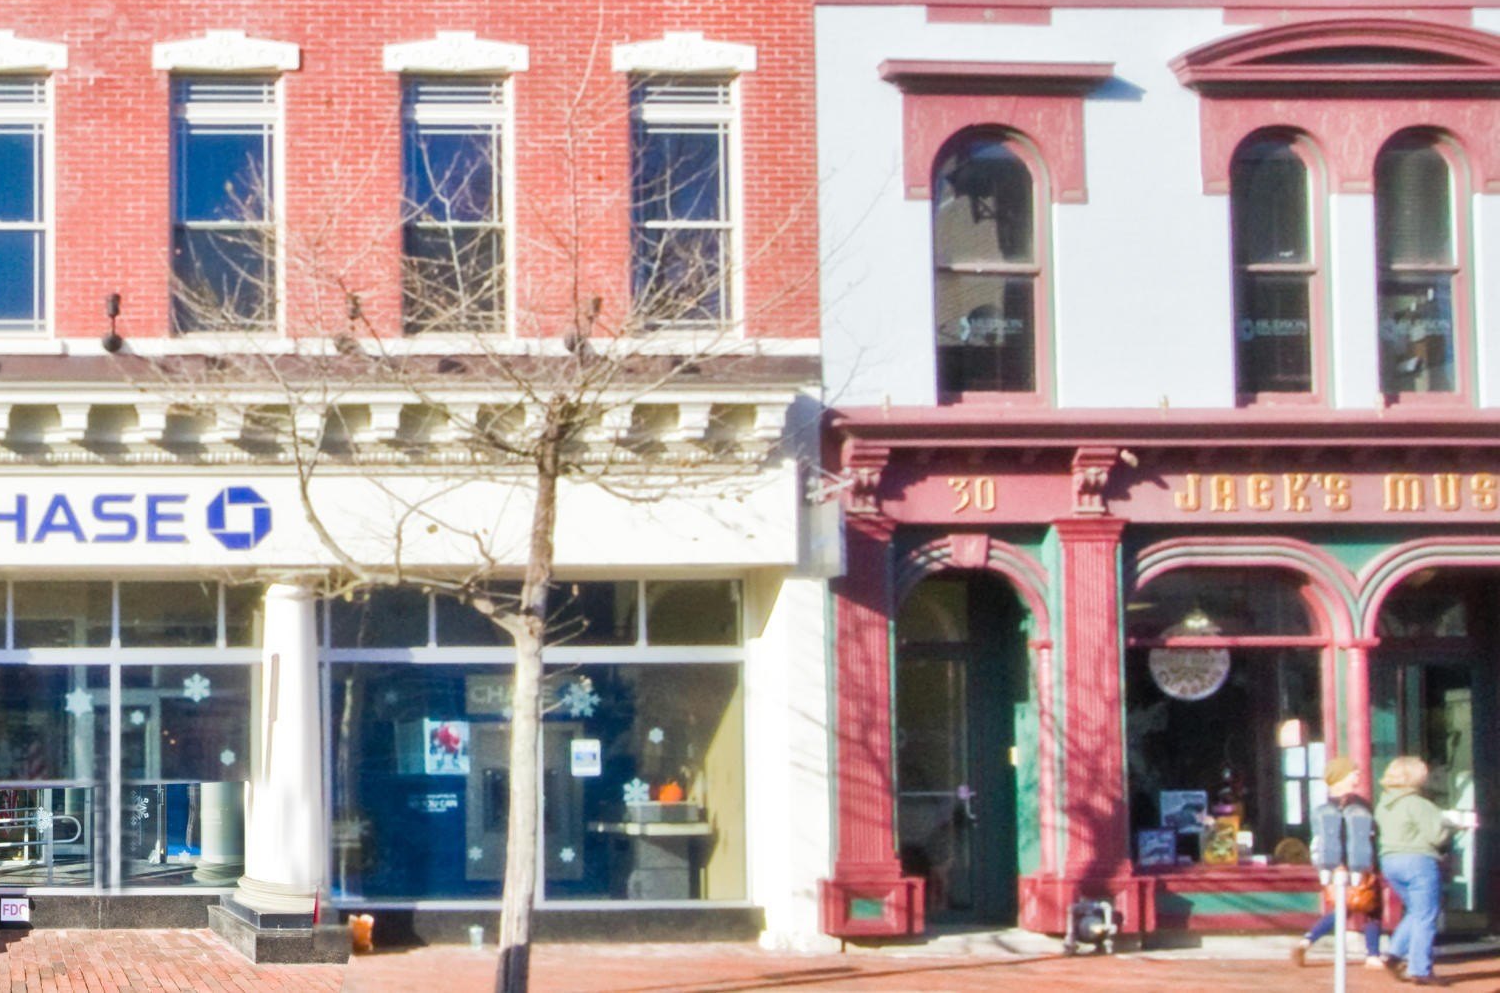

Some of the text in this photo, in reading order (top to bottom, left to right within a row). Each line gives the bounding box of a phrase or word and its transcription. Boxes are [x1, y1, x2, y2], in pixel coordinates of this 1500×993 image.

[948, 477, 997, 513] 30
[1174, 473, 1498, 512] JACK'S MUS
[470, 686, 553, 703] CHE
